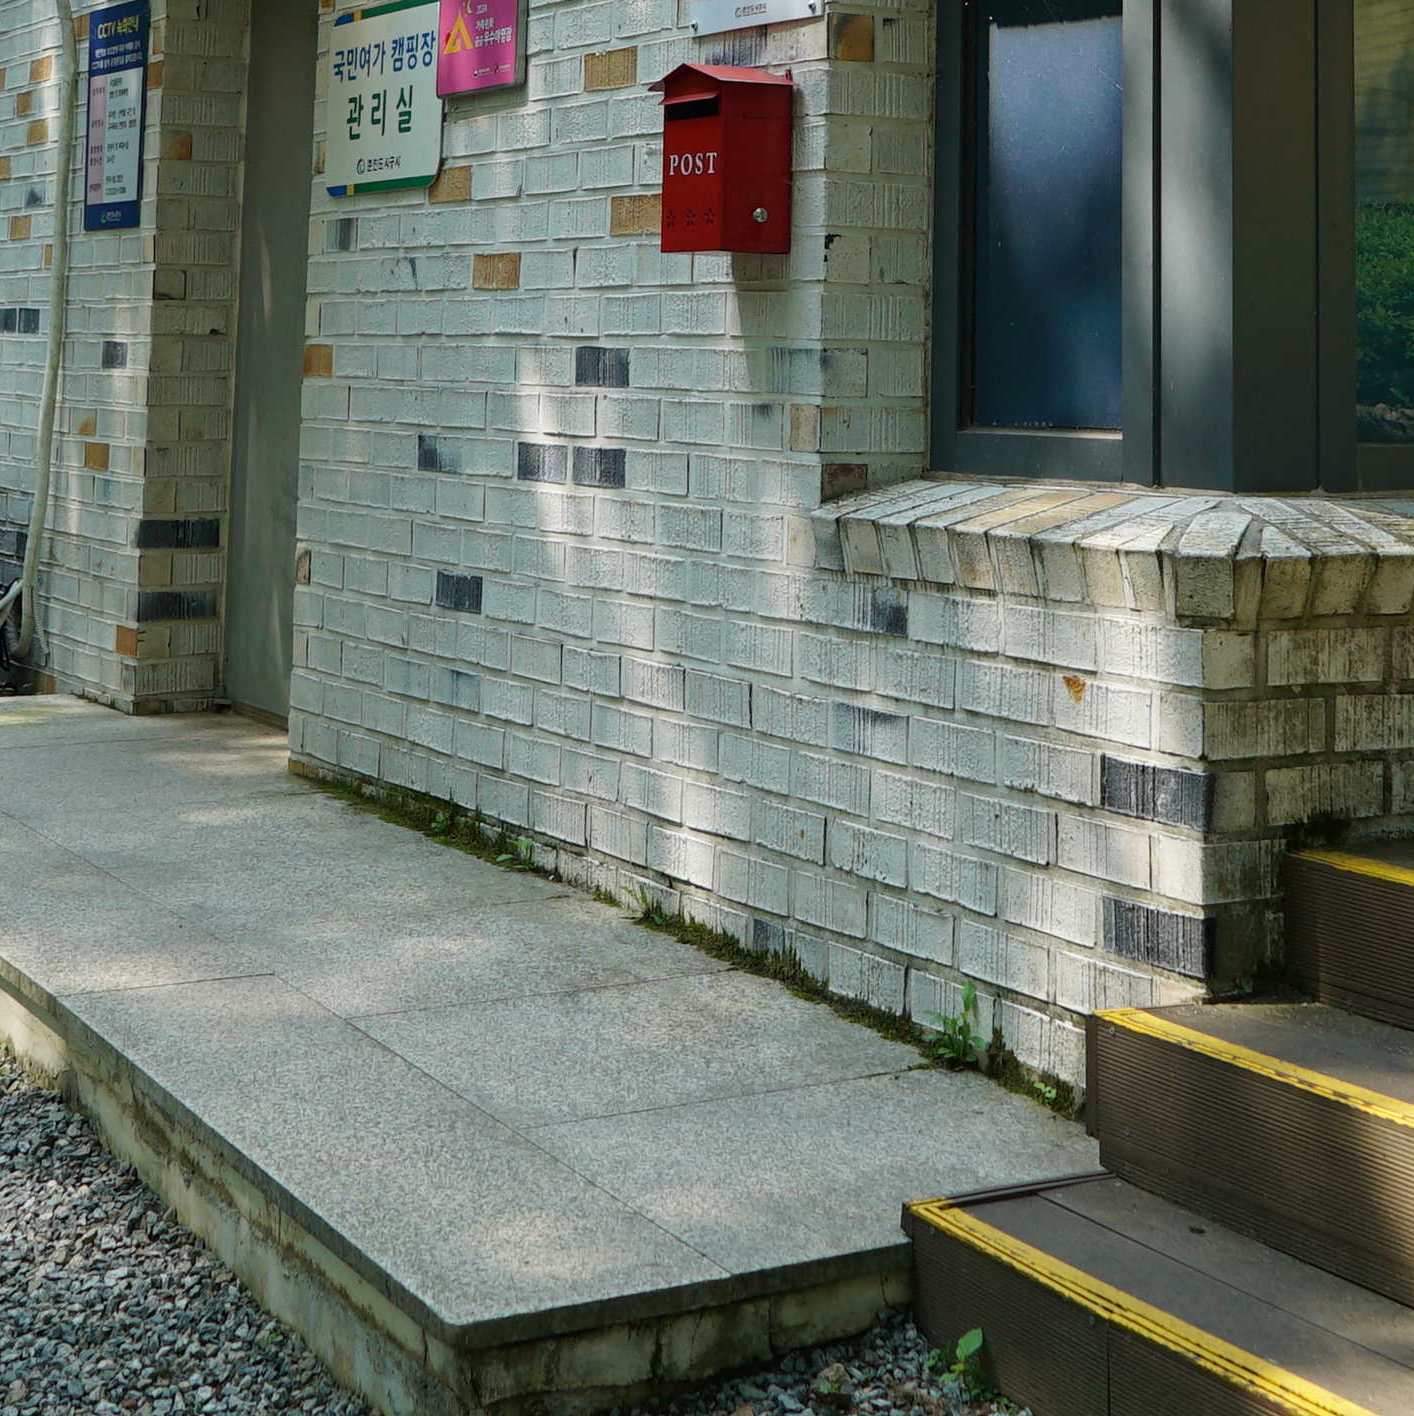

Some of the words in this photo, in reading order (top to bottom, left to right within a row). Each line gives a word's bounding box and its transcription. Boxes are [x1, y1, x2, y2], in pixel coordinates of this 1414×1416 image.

[97, 21, 116, 39] CCTV
[333, 39, 386, 83] 국민여가
[391, 31, 436, 72] 캠핑장
[346, 85, 414, 140] 관리실
[669, 151, 719, 176] POST
